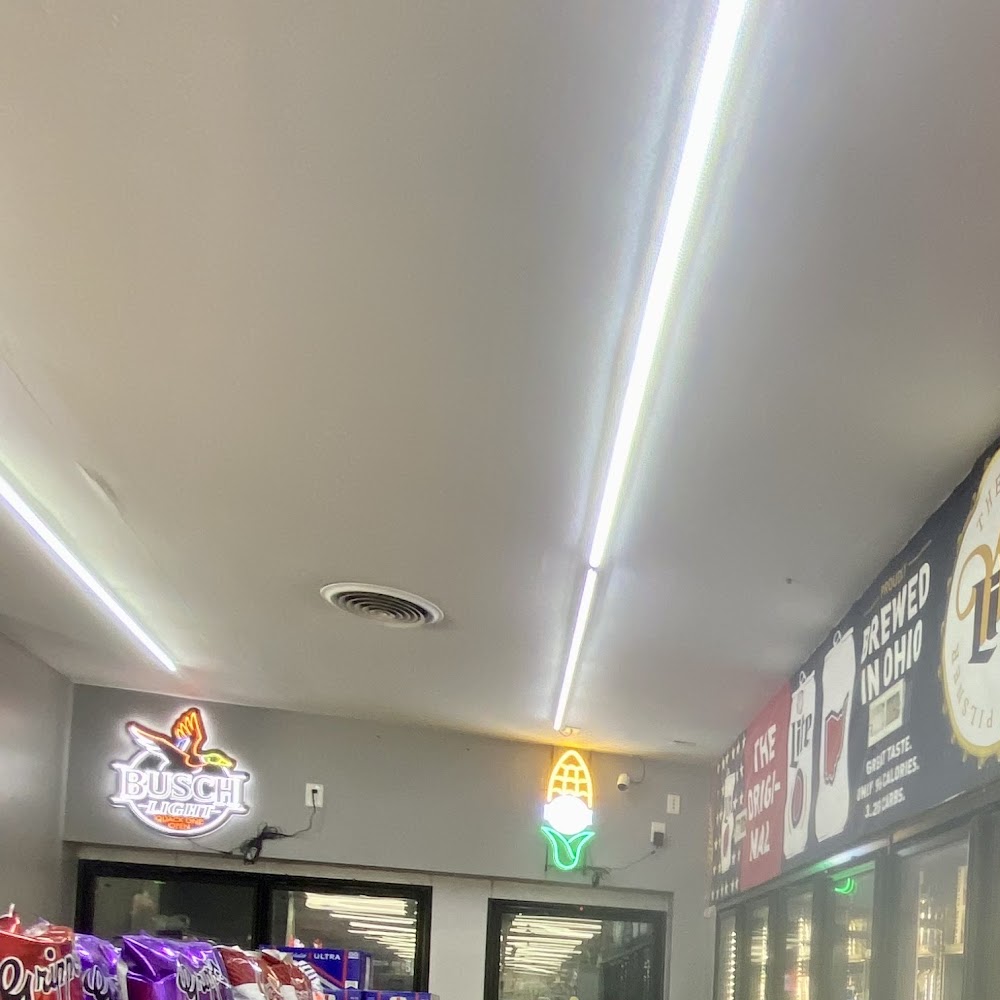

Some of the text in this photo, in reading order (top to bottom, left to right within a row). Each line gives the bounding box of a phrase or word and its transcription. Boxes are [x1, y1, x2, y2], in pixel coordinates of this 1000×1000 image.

[861, 562, 931, 664] BREWED
[861, 619, 923, 705] IN OHIO
[950, 641, 994, 729] PILSNER
[753, 724, 777, 773] THE
[789, 713, 812, 768] Lite
[111, 763, 249, 812] BUSCH
[145, 800, 213, 819] LIGHT
[747, 771, 781, 821] ORIGI-
[749, 820, 770, 862] NAL
[313, 953, 341, 961] ULTRA
